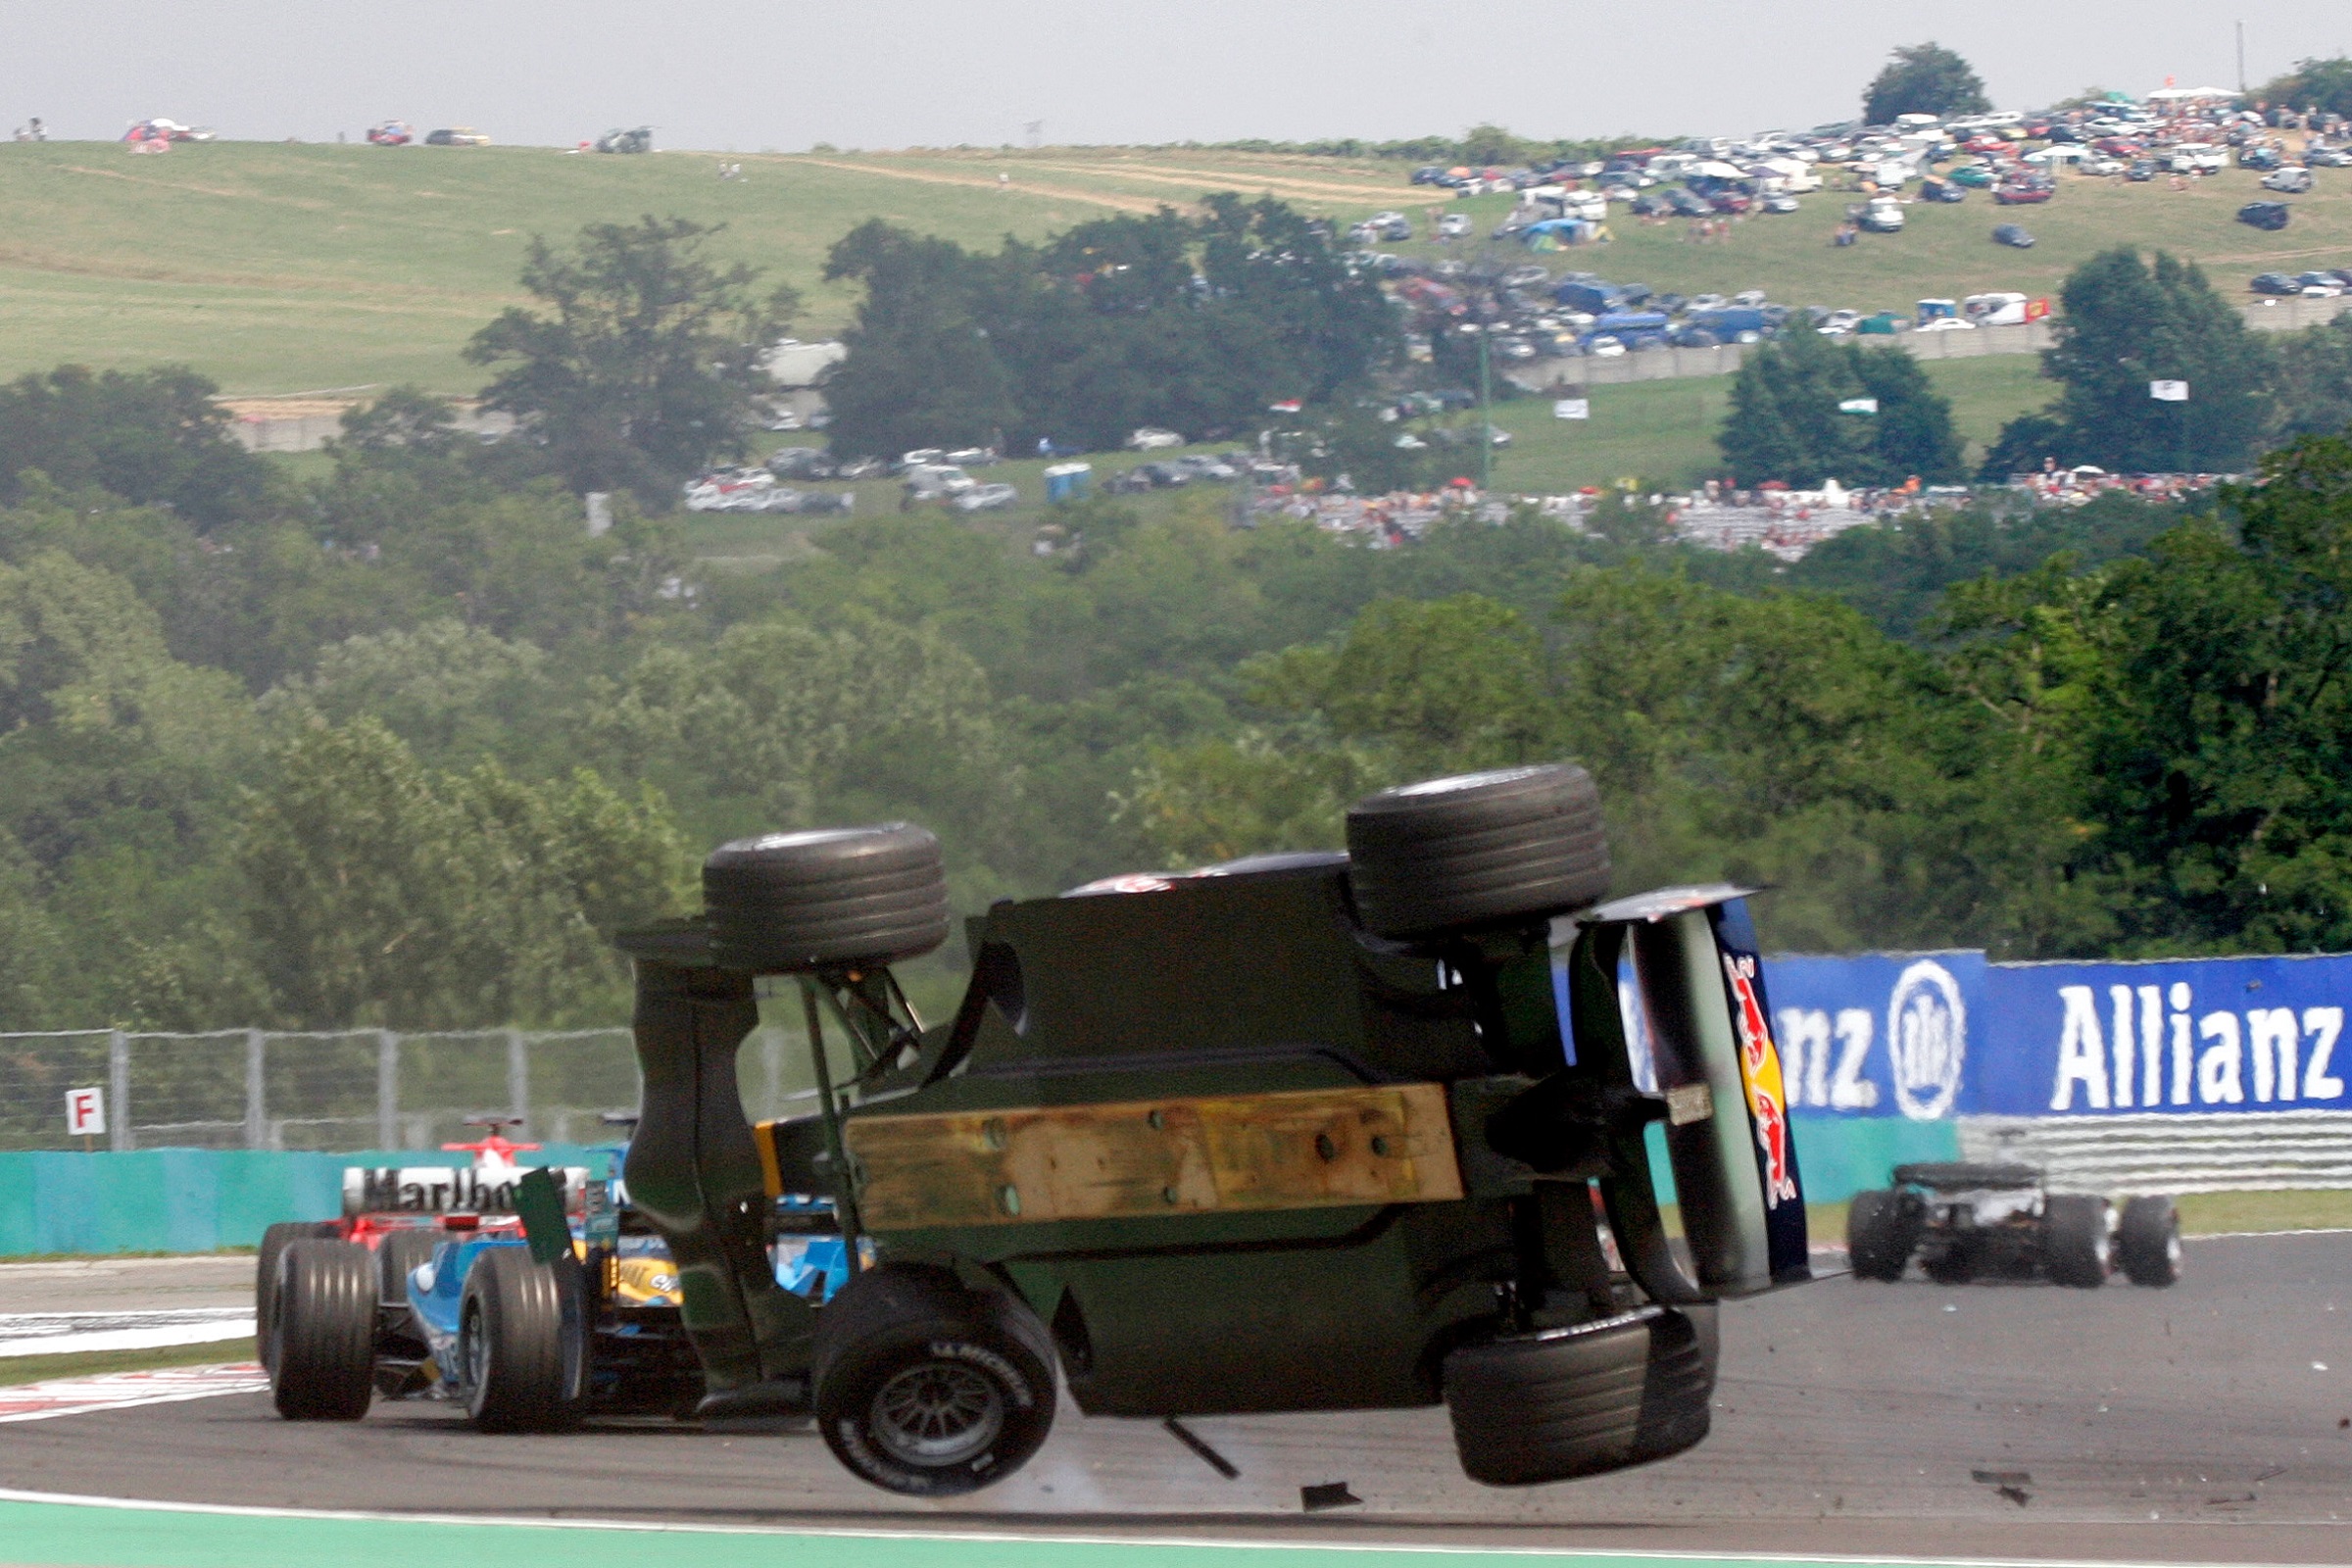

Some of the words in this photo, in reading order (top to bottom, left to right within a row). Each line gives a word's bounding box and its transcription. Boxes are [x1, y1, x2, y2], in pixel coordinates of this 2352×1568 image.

[2050, 981, 2345, 1111] Allianz
[75, 1094, 94, 1129] F
[364, 1168, 514, 1213] Marlbo
